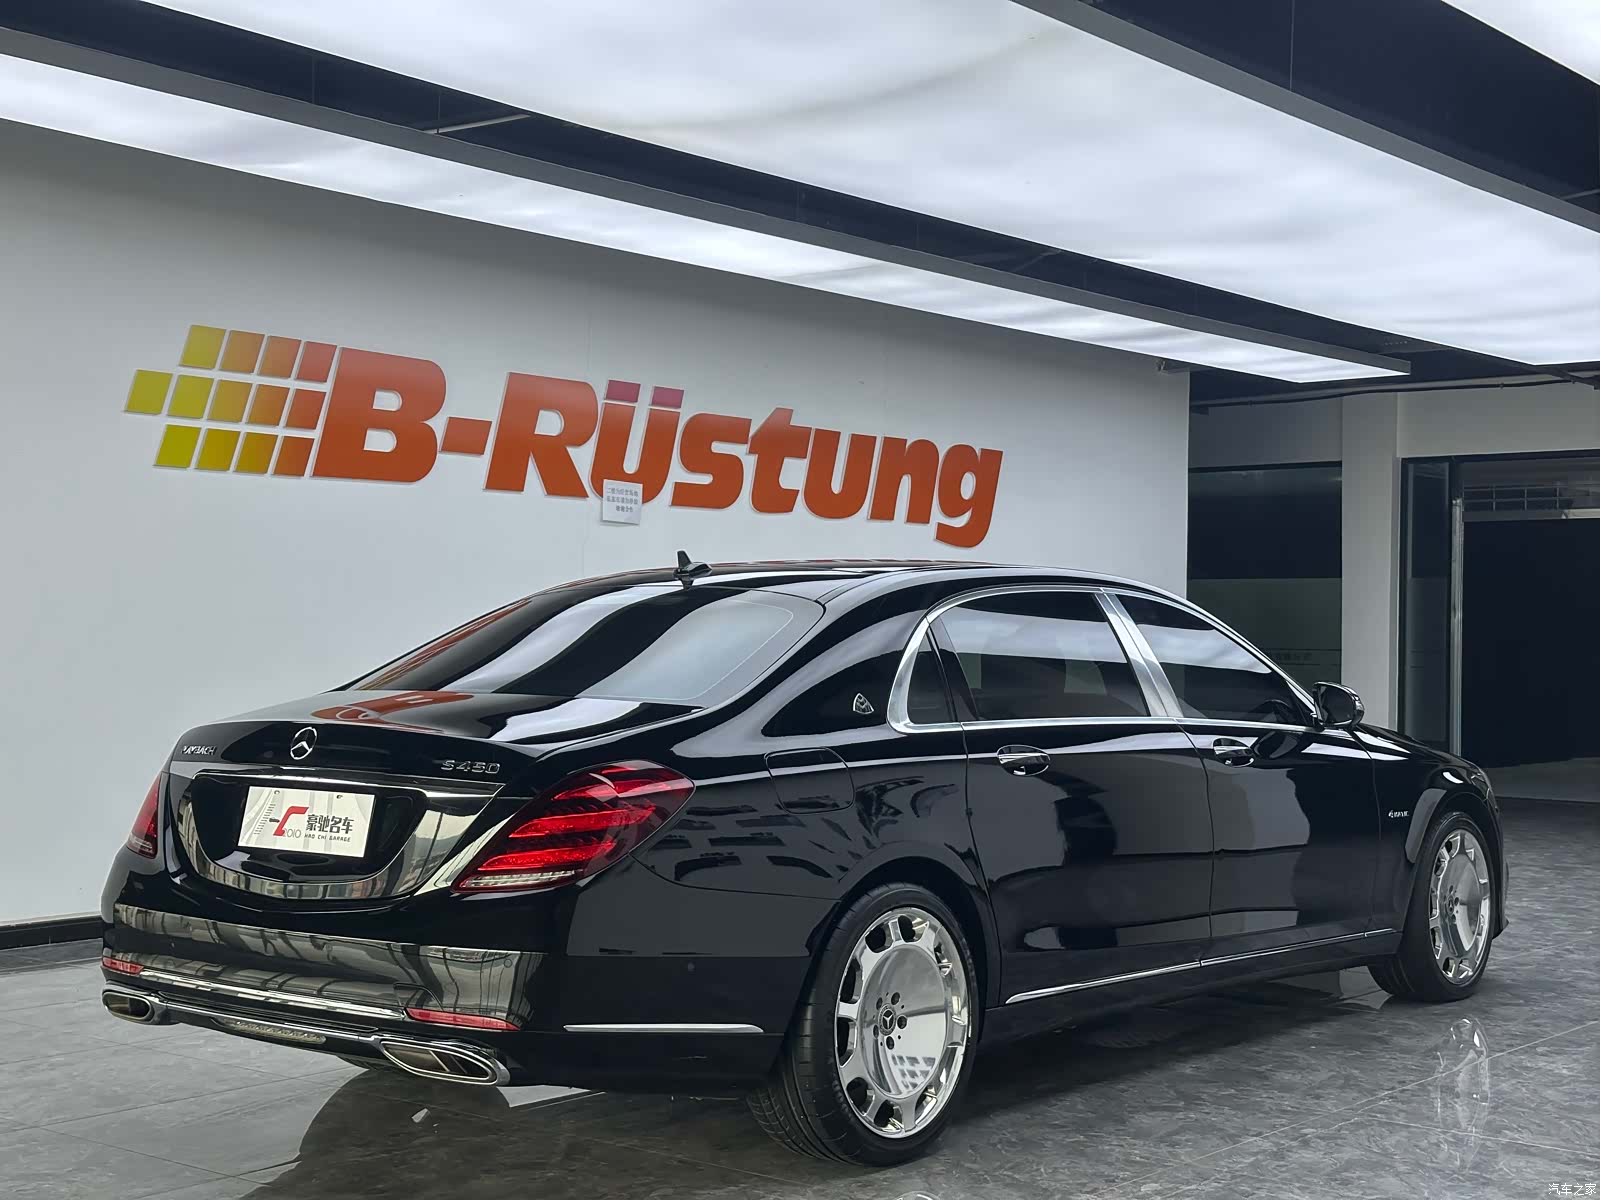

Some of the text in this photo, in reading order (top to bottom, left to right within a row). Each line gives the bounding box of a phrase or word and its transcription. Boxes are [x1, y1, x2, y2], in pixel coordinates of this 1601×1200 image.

[311, 346, 1003, 548] B-Rüstung
[440, 760, 500, 774] S450
[306, 814, 354, 834] 豪驰名车
